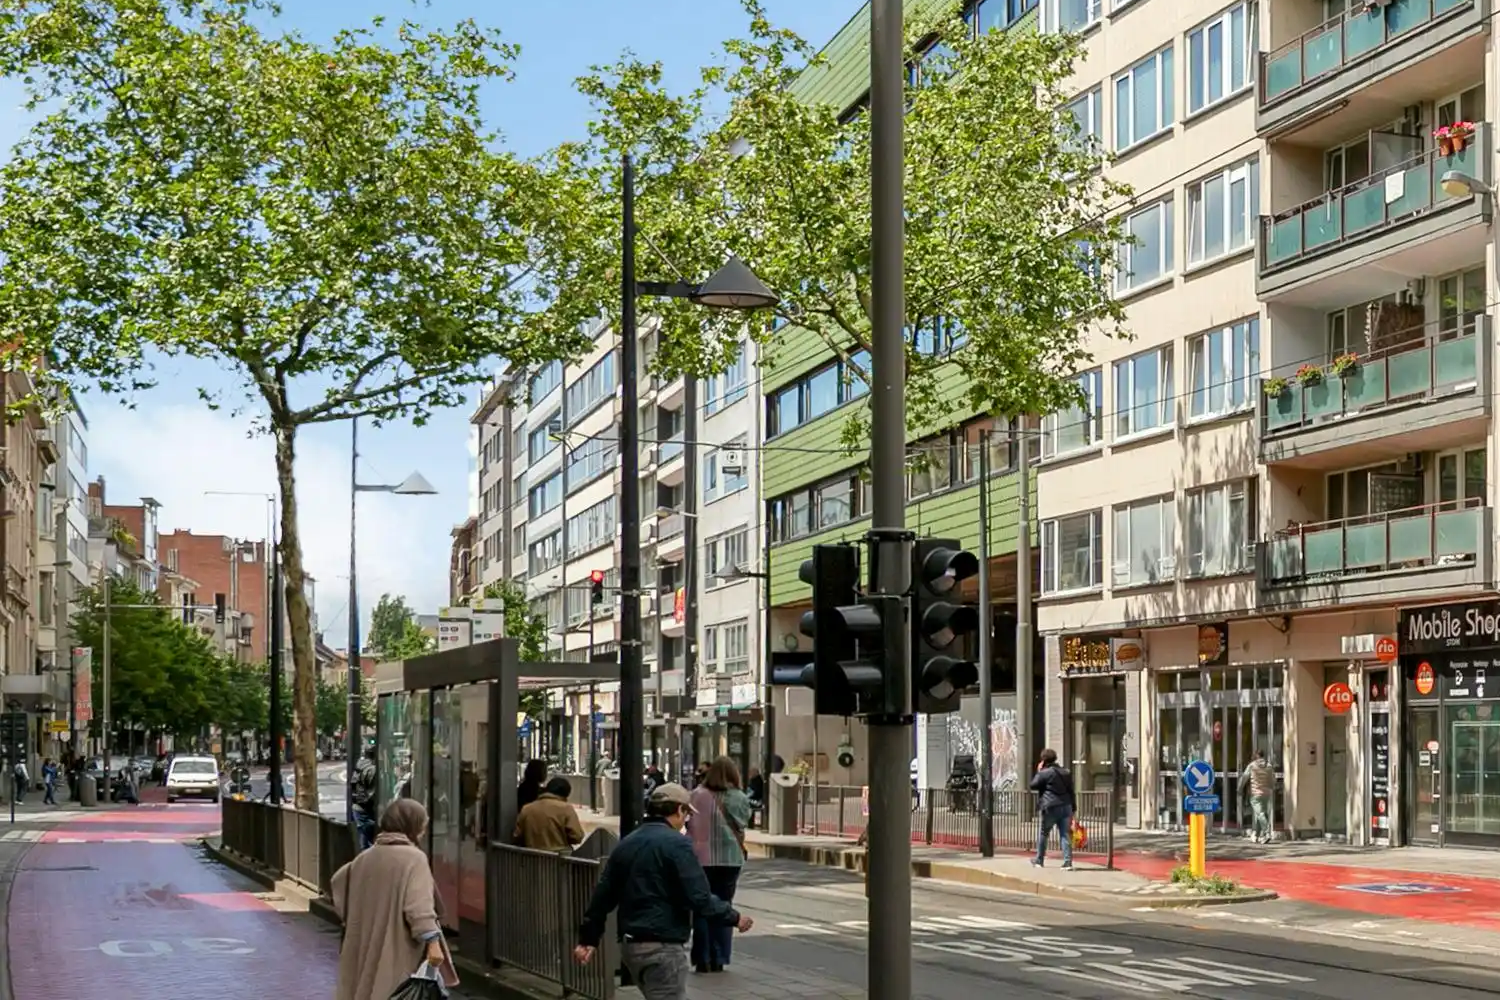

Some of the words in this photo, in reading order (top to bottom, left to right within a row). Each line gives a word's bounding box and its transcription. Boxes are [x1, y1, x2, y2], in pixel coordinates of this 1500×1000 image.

[1408, 610, 1461, 640] Mobile
[1378, 639, 1394, 653] ria
[1329, 687, 1350, 703] ria
[911, 934, 1134, 963] BUS
[1020, 956, 1317, 992] TAXI
